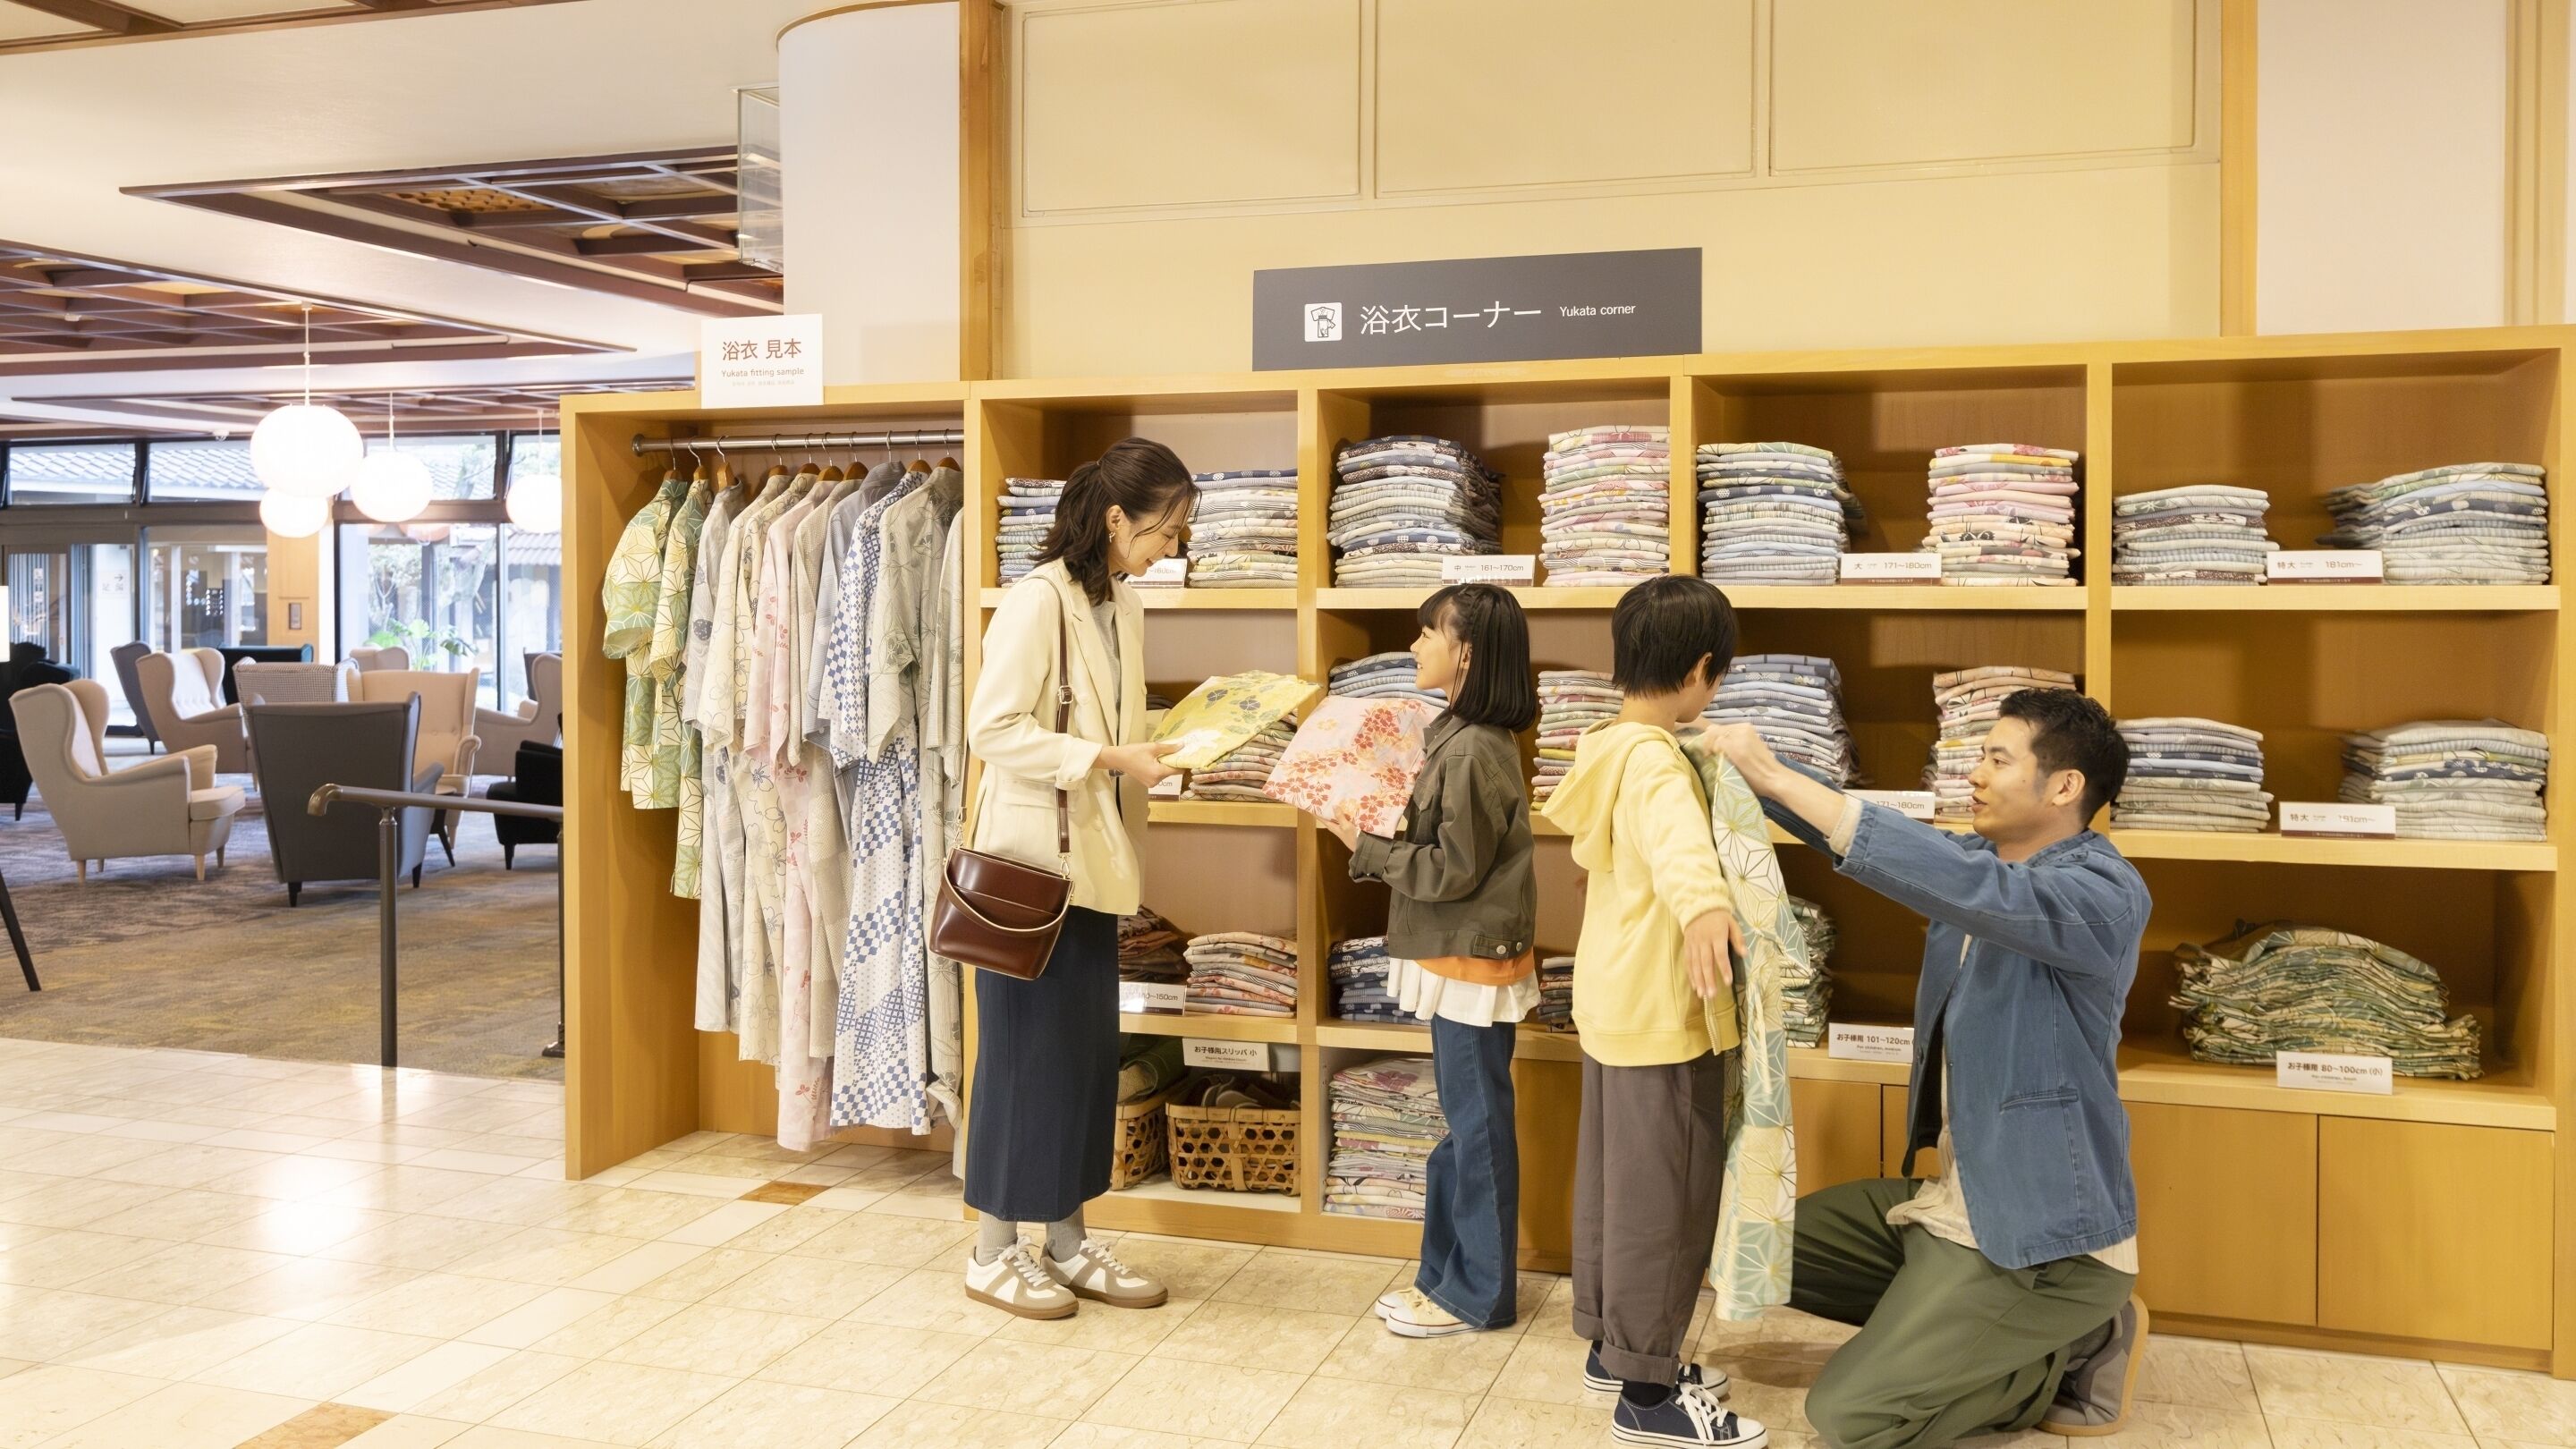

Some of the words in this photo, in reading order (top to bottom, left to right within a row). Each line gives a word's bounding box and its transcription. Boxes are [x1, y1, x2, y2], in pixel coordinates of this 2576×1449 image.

[1360, 299, 1542, 335] 浴衣コーナー
[1559, 305, 1597, 318] Yukata
[1600, 303, 1636, 316] corner
[722, 339, 758, 361] 浴衣
[765, 337, 802, 360] 見本
[721, 369, 749, 377] Yukata
[750, 368, 775, 377] fitting
[776, 367, 805, 377] sample
[2277, 561, 2296, 570] 特大
[2290, 813, 2309, 823] 特大
[1836, 1034, 1864, 1043] お子様用
[1194, 1046, 1248, 1056] お子様用スリッパ
[1249, 1049, 1258, 1057] 小
[2287, 1062, 2318, 1072] お子様用
